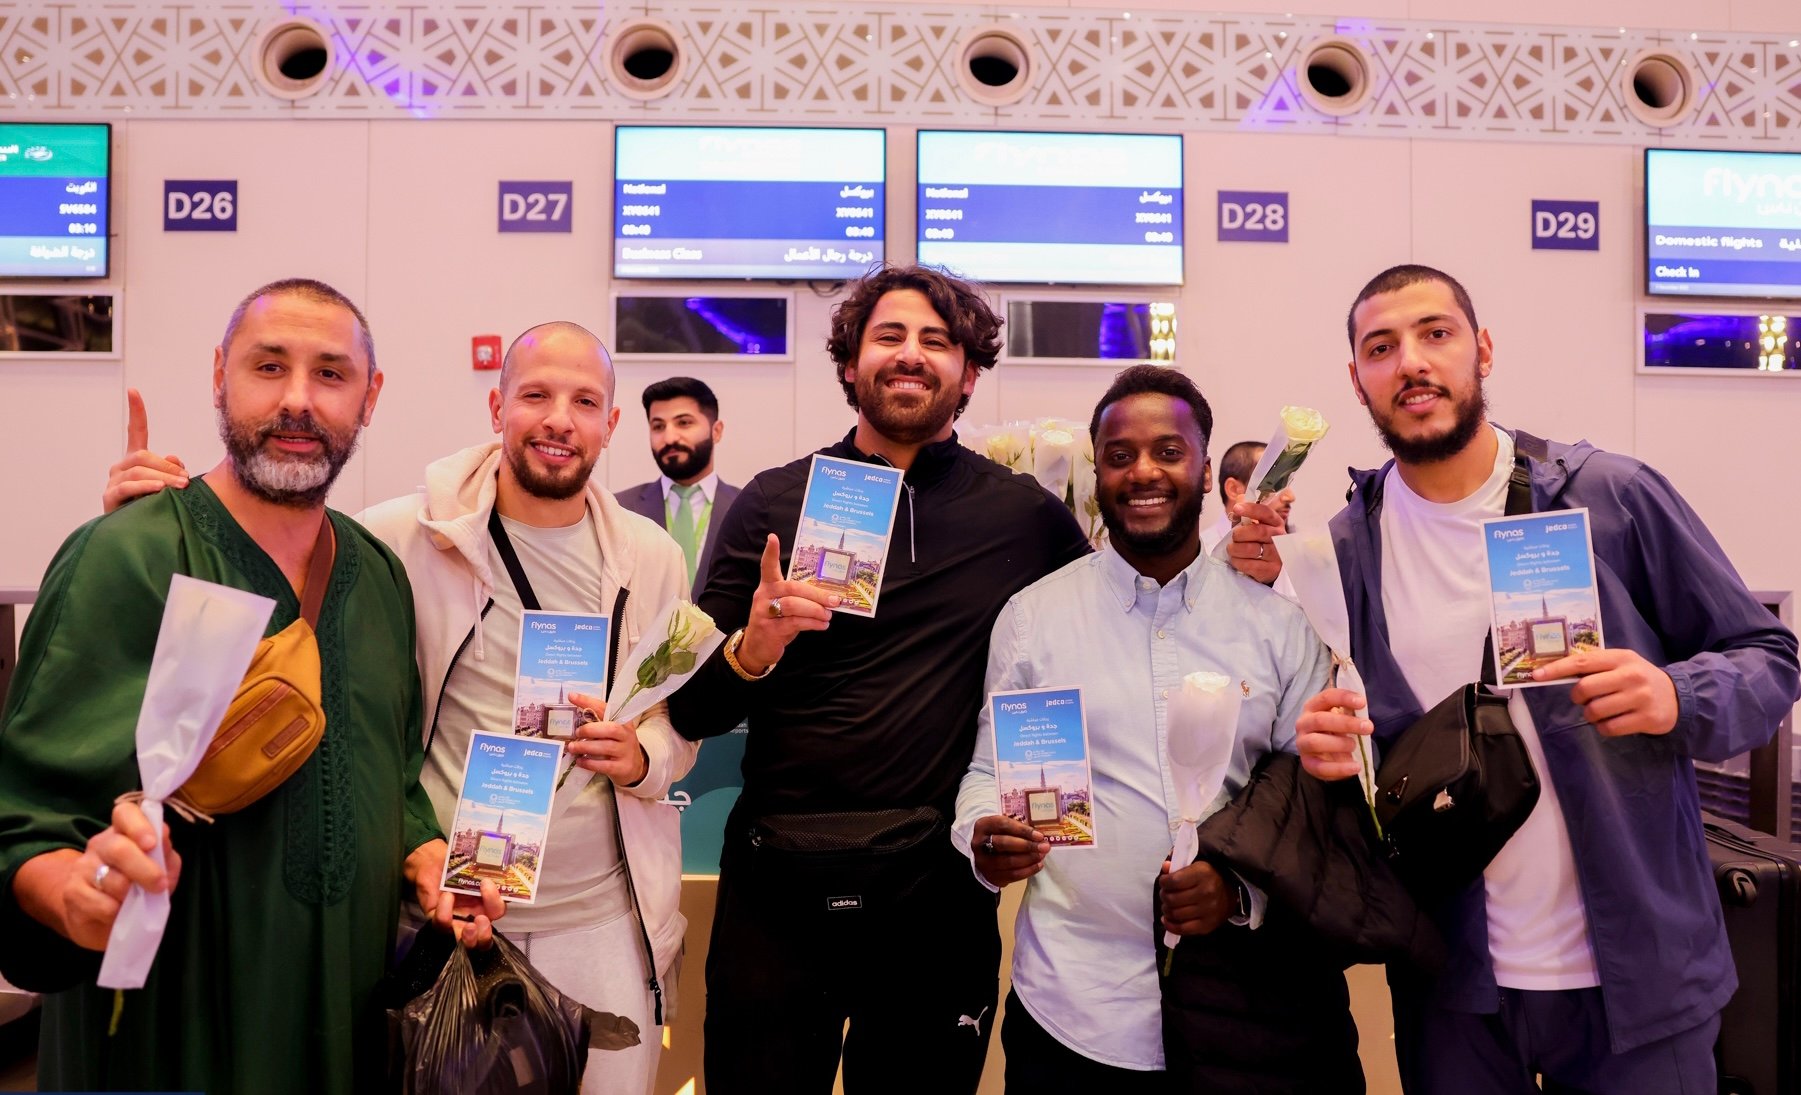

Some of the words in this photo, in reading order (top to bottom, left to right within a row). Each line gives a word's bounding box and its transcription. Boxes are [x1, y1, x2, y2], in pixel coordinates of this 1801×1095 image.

[66, 181, 98, 195] الكويت
[168, 191, 234, 220] D26
[503, 193, 568, 221] D27
[1222, 202, 1285, 231] D28
[1535, 211, 1596, 240] D29
[1655, 234, 1718, 247] Domestic
[1720, 235, 1763, 250] flights
[1655, 266, 1687, 278] Check
[821, 466, 847, 477] flynas
[823, 502, 843, 511] Jeddah
[850, 507, 874, 516] Brussels
[1494, 528, 1524, 539] flynas
[1541, 565, 1570, 573] Brussels
[531, 621, 556, 631] flynas
[1000, 702, 1027, 712] flynas
[1041, 737, 1066, 745] Brussels
[479, 742, 505, 753] flynas
[481, 782, 503, 790] Jeddah
[509, 786, 534, 795] Brussels
